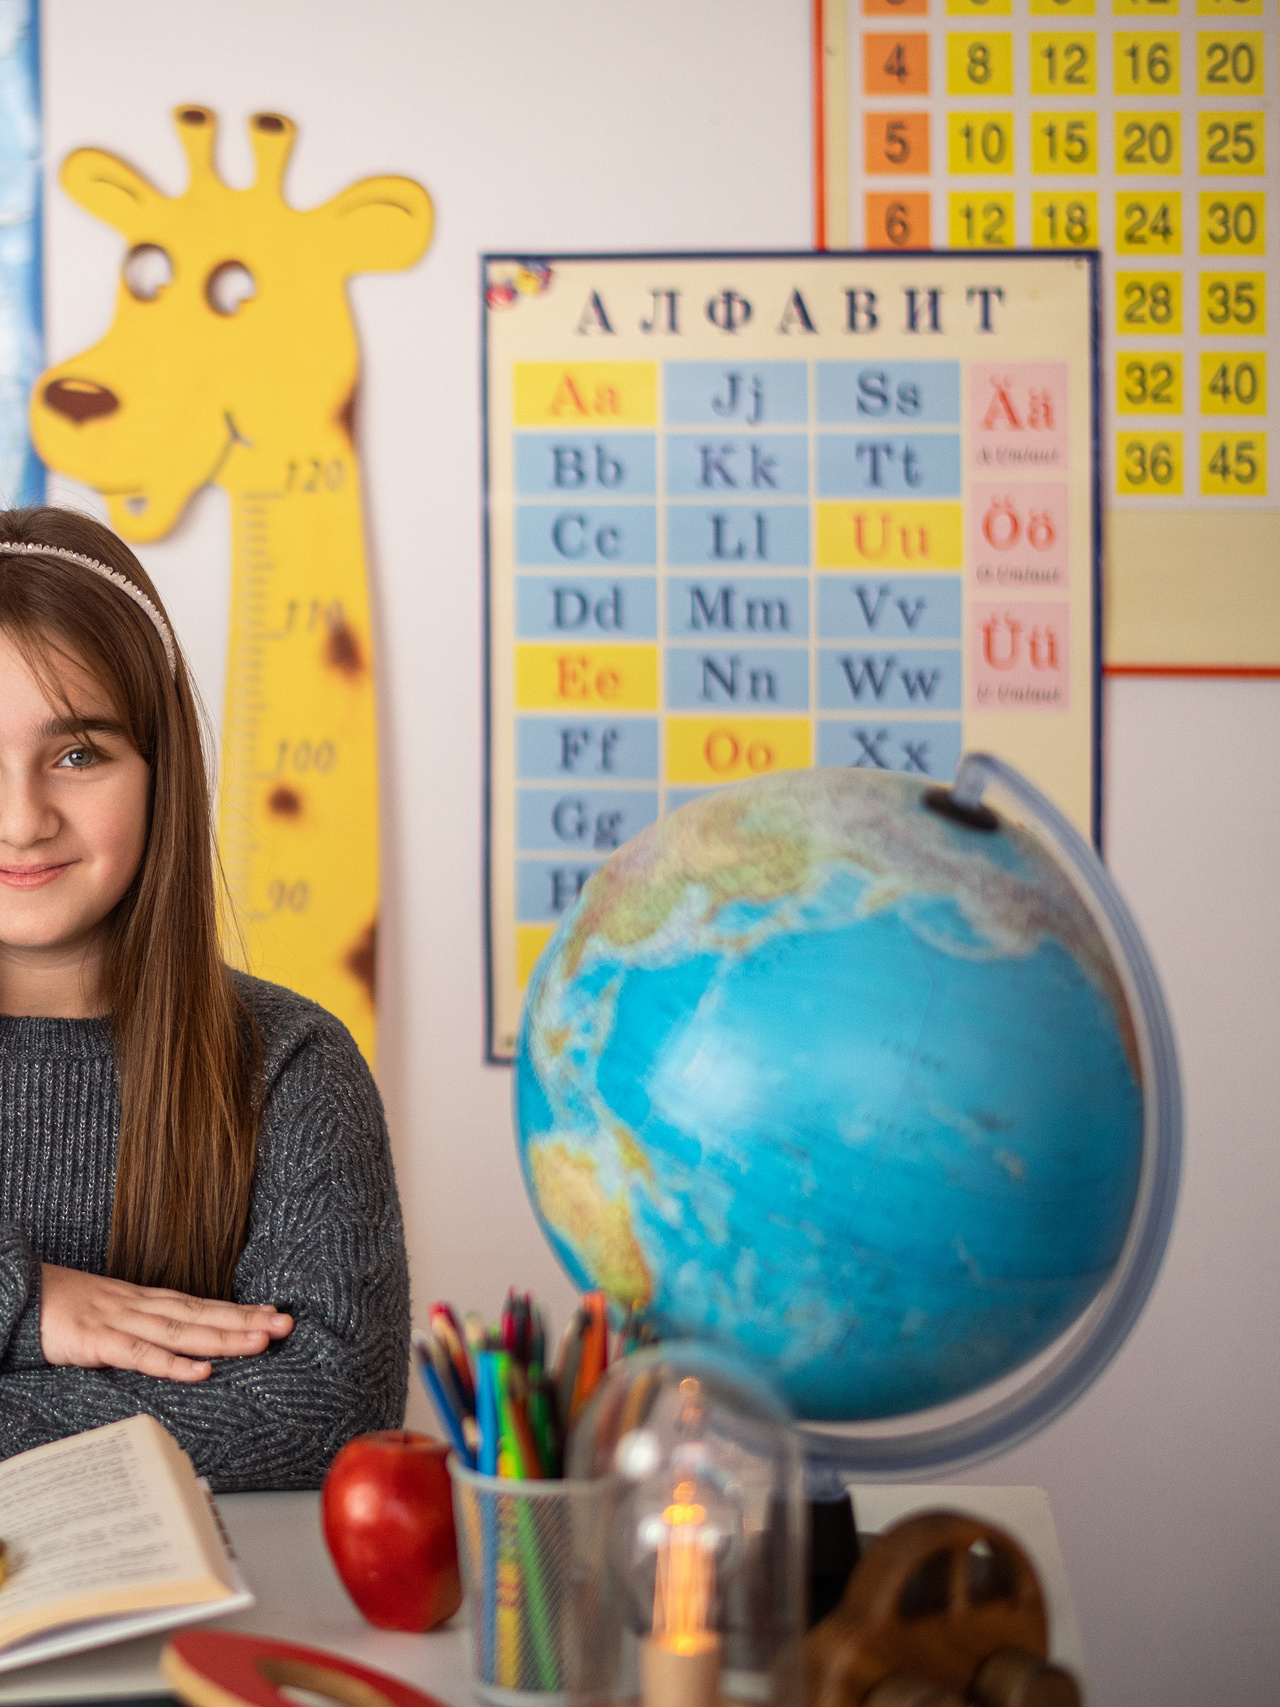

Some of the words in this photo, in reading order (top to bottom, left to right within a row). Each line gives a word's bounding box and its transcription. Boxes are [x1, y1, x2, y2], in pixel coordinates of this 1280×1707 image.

[883, 42, 909, 84] 4
[966, 42, 992, 84] 8
[1042, 42, 1089, 84] 12
[1125, 42, 1172, 84] 16
[1206, 42, 1256, 84] 20
[884, 121, 910, 164] 5
[960, 122, 1007, 164] 10
[1042, 121, 1090, 164] 15
[1124, 122, 1173, 164] 20
[1207, 122, 1256, 165] 25
[884, 202, 910, 246] 6
[960, 203, 1007, 245] 12
[1043, 202, 1090, 246] 18
[1124, 202, 1173, 244] 24
[1207, 202, 1258, 245] 30
[575, 286, 1006, 335] АЛФАВИТ
[1124, 281, 1174, 324] 28
[1207, 281, 1258, 325] 35
[548, 372, 623, 417] Aa
[711, 371, 766, 426] Jj
[855, 369, 923, 417] Ss
[980, 376, 1057, 431] Ää
[1124, 361, 1175, 405] 32
[1208, 361, 1259, 405] 40
[283, 459, 347, 494] 120
[549, 443, 627, 490] Bb
[699, 443, 780, 490] Kk
[854, 442, 922, 489] Tt
[1124, 441, 1175, 485] 36
[1208, 441, 1259, 485] 45
[550, 512, 621, 560] Cc
[709, 511, 769, 561] Ll
[852, 511, 931, 560] Uu
[980, 495, 1058, 552] Öö
[550, 584, 626, 631] Dd
[689, 585, 791, 631] Mm
[853, 584, 927, 631] Vv
[980, 612, 1061, 672] Üü
[555, 654, 622, 701] Ee
[700, 655, 779, 701] Nn
[839, 656, 942, 701] Ww
[273, 736, 337, 775] 100
[558, 726, 620, 773] Ff
[702, 726, 776, 774] Oo
[851, 729, 931, 771] Xx
[551, 797, 623, 851] Gg
[267, 876, 311, 915] 90
